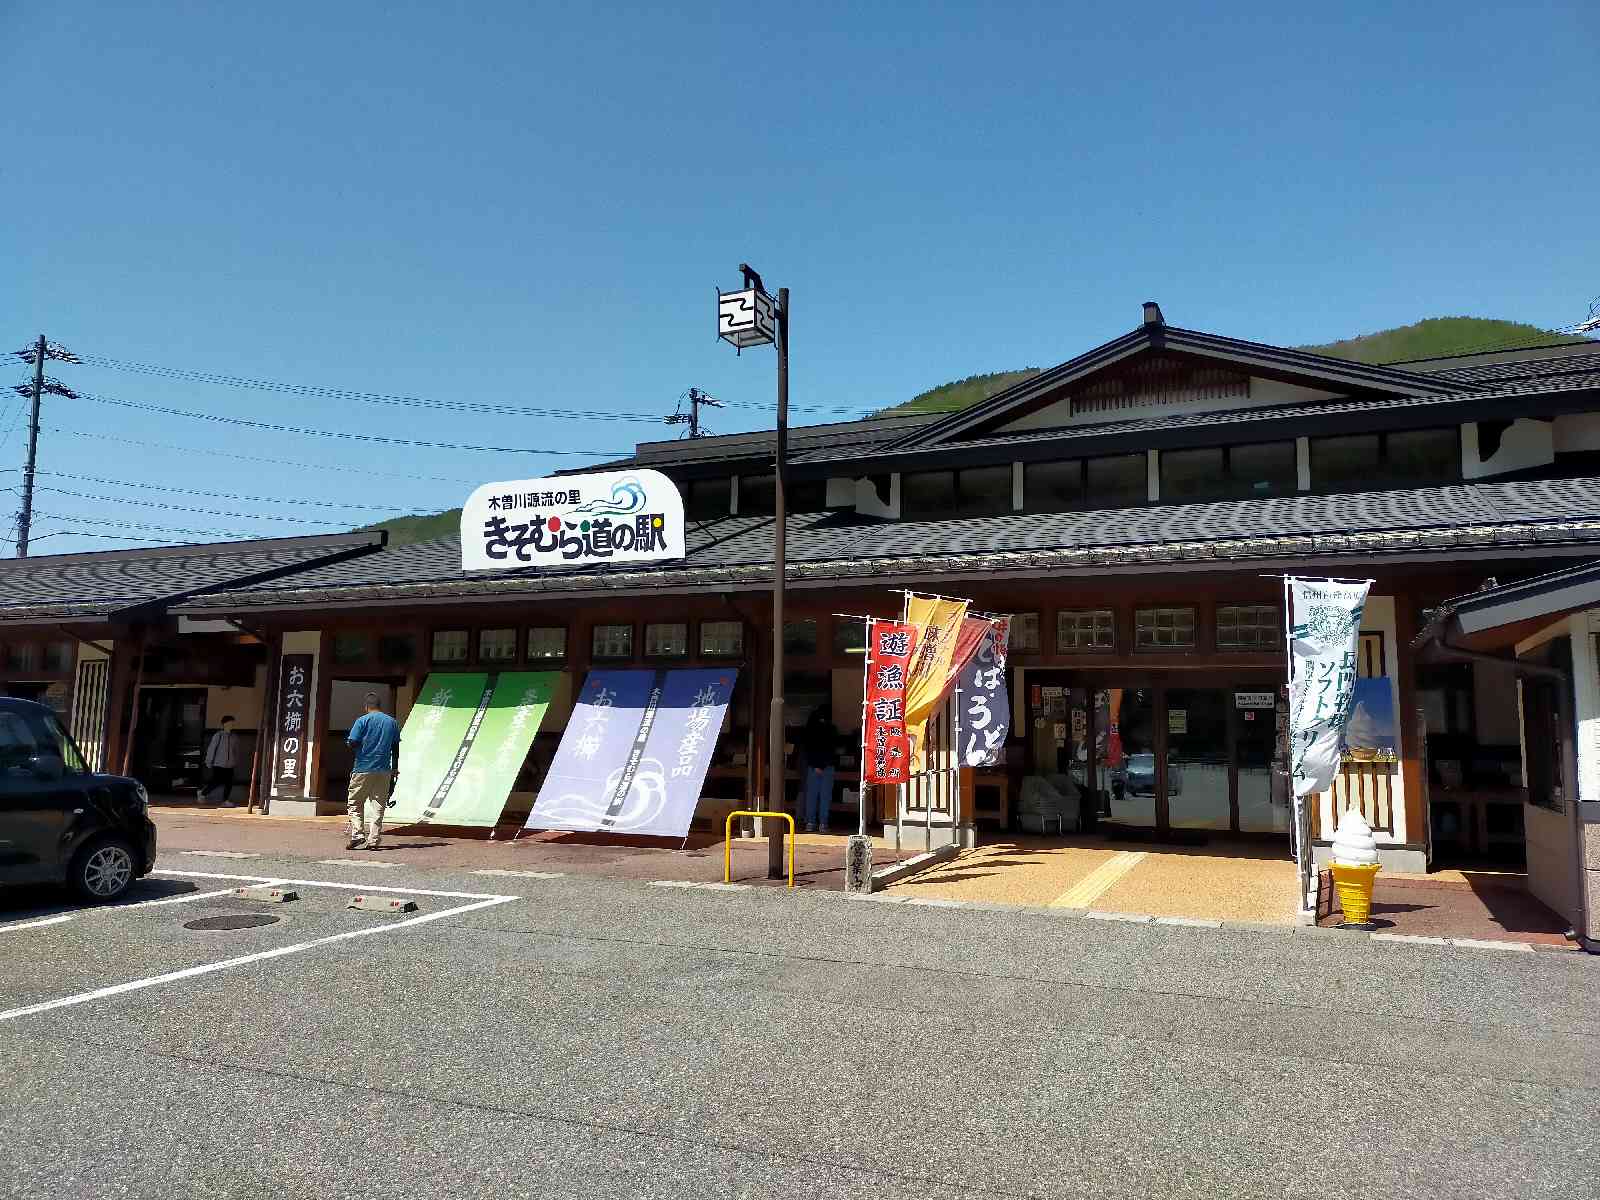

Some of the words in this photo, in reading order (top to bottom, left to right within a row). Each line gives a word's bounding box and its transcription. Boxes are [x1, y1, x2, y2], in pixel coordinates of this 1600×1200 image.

[484, 513, 668, 561] きそむら道の駅
[488, 490, 581, 511] 木曽川源流の里
[280, 665, 304, 779] お六櫛の里
[875, 632, 911, 722] 遊漁証
[671, 685, 716, 778] 地場産品
